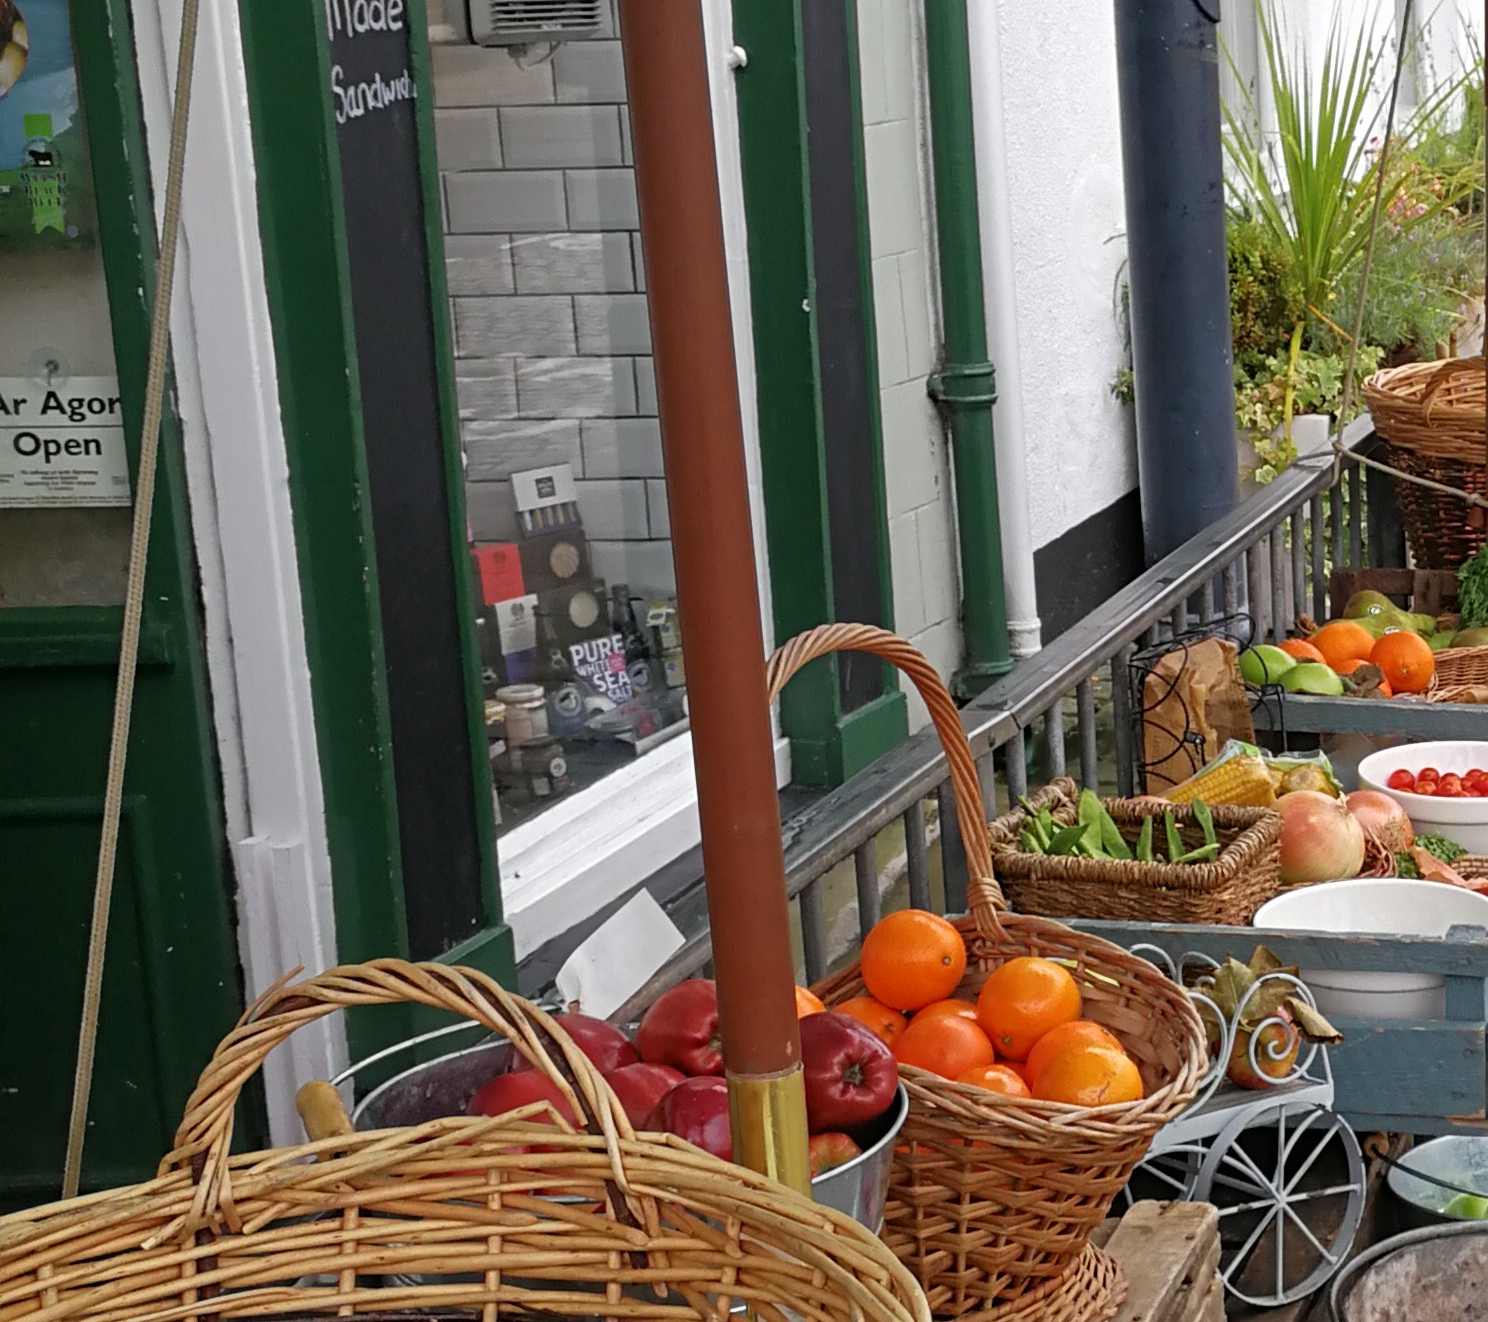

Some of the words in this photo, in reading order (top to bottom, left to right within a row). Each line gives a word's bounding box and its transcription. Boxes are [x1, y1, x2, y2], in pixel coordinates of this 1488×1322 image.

[40, 390, 122, 423] Agor
[13, 431, 103, 464] Open
[569, 634, 626, 666] PURE
[576, 658, 612, 677] WHIT
[593, 673, 632, 693] SEA
